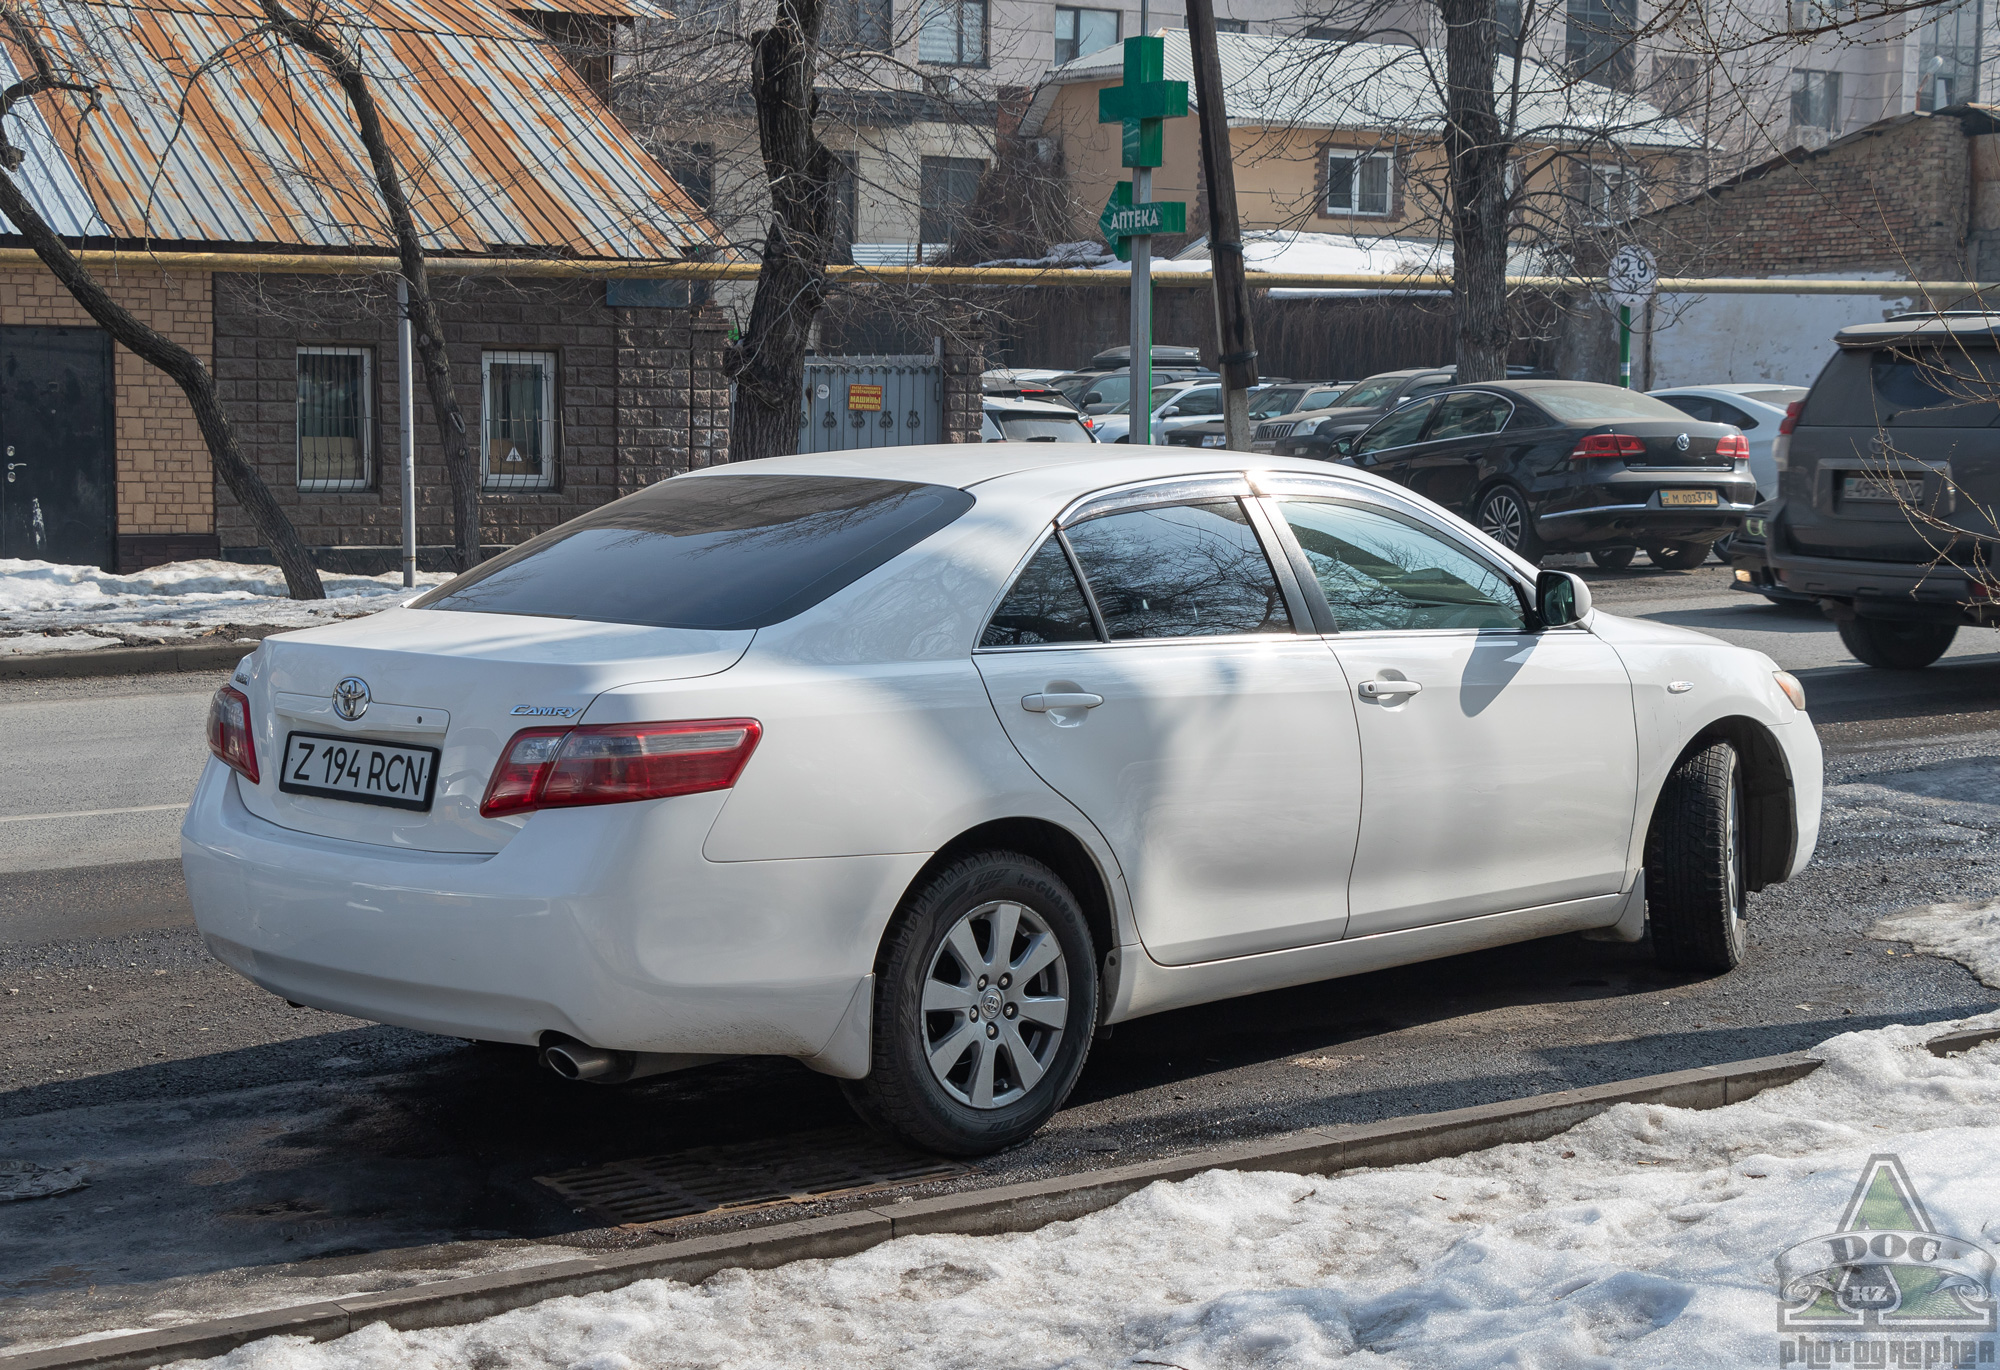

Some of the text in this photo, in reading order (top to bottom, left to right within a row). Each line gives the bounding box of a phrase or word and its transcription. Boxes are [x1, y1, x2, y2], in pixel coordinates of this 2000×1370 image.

[1110, 208, 1159, 230] АПТЕКА
[850, 396, 880, 404] МАШИНЫ
[1682, 491, 1713, 503] 003379
[509, 704, 583, 718] CAMRY
[293, 742, 425, 796] Z 194 RCN
